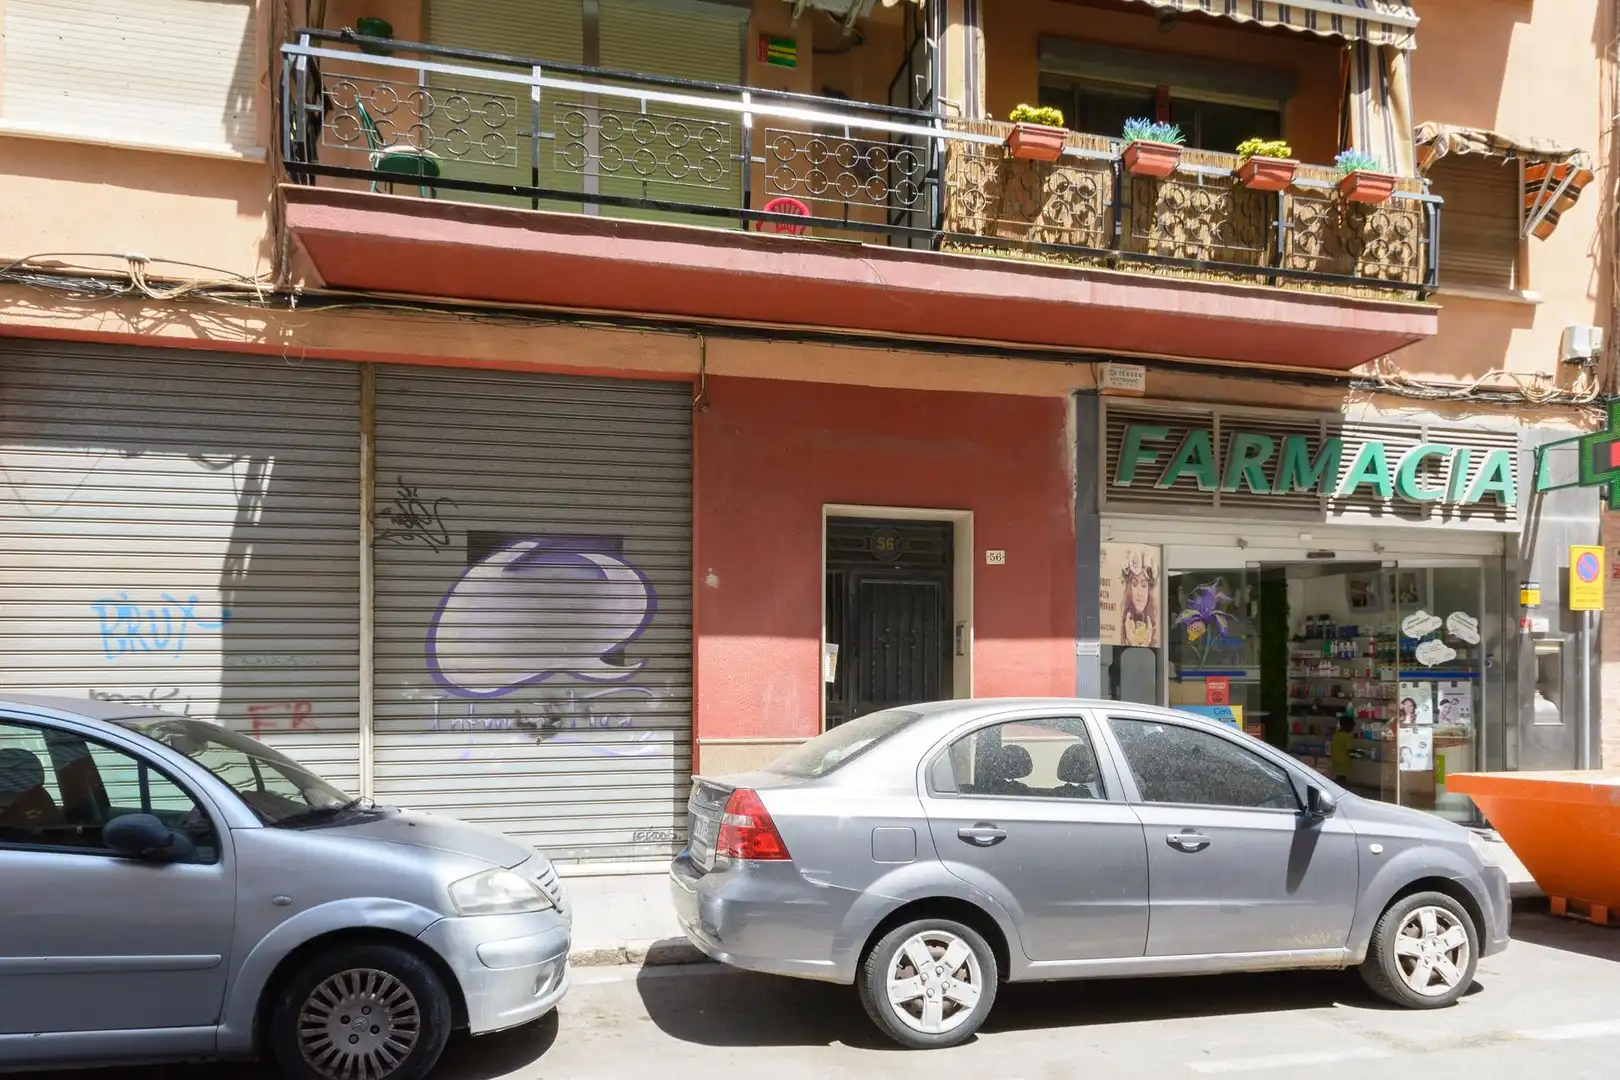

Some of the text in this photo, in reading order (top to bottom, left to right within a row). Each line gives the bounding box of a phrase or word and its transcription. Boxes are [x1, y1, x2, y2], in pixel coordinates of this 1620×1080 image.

[1113, 424, 1517, 504] FARMACIA
[877, 537, 895, 551] 56
[989, 552, 1002, 561] 56
